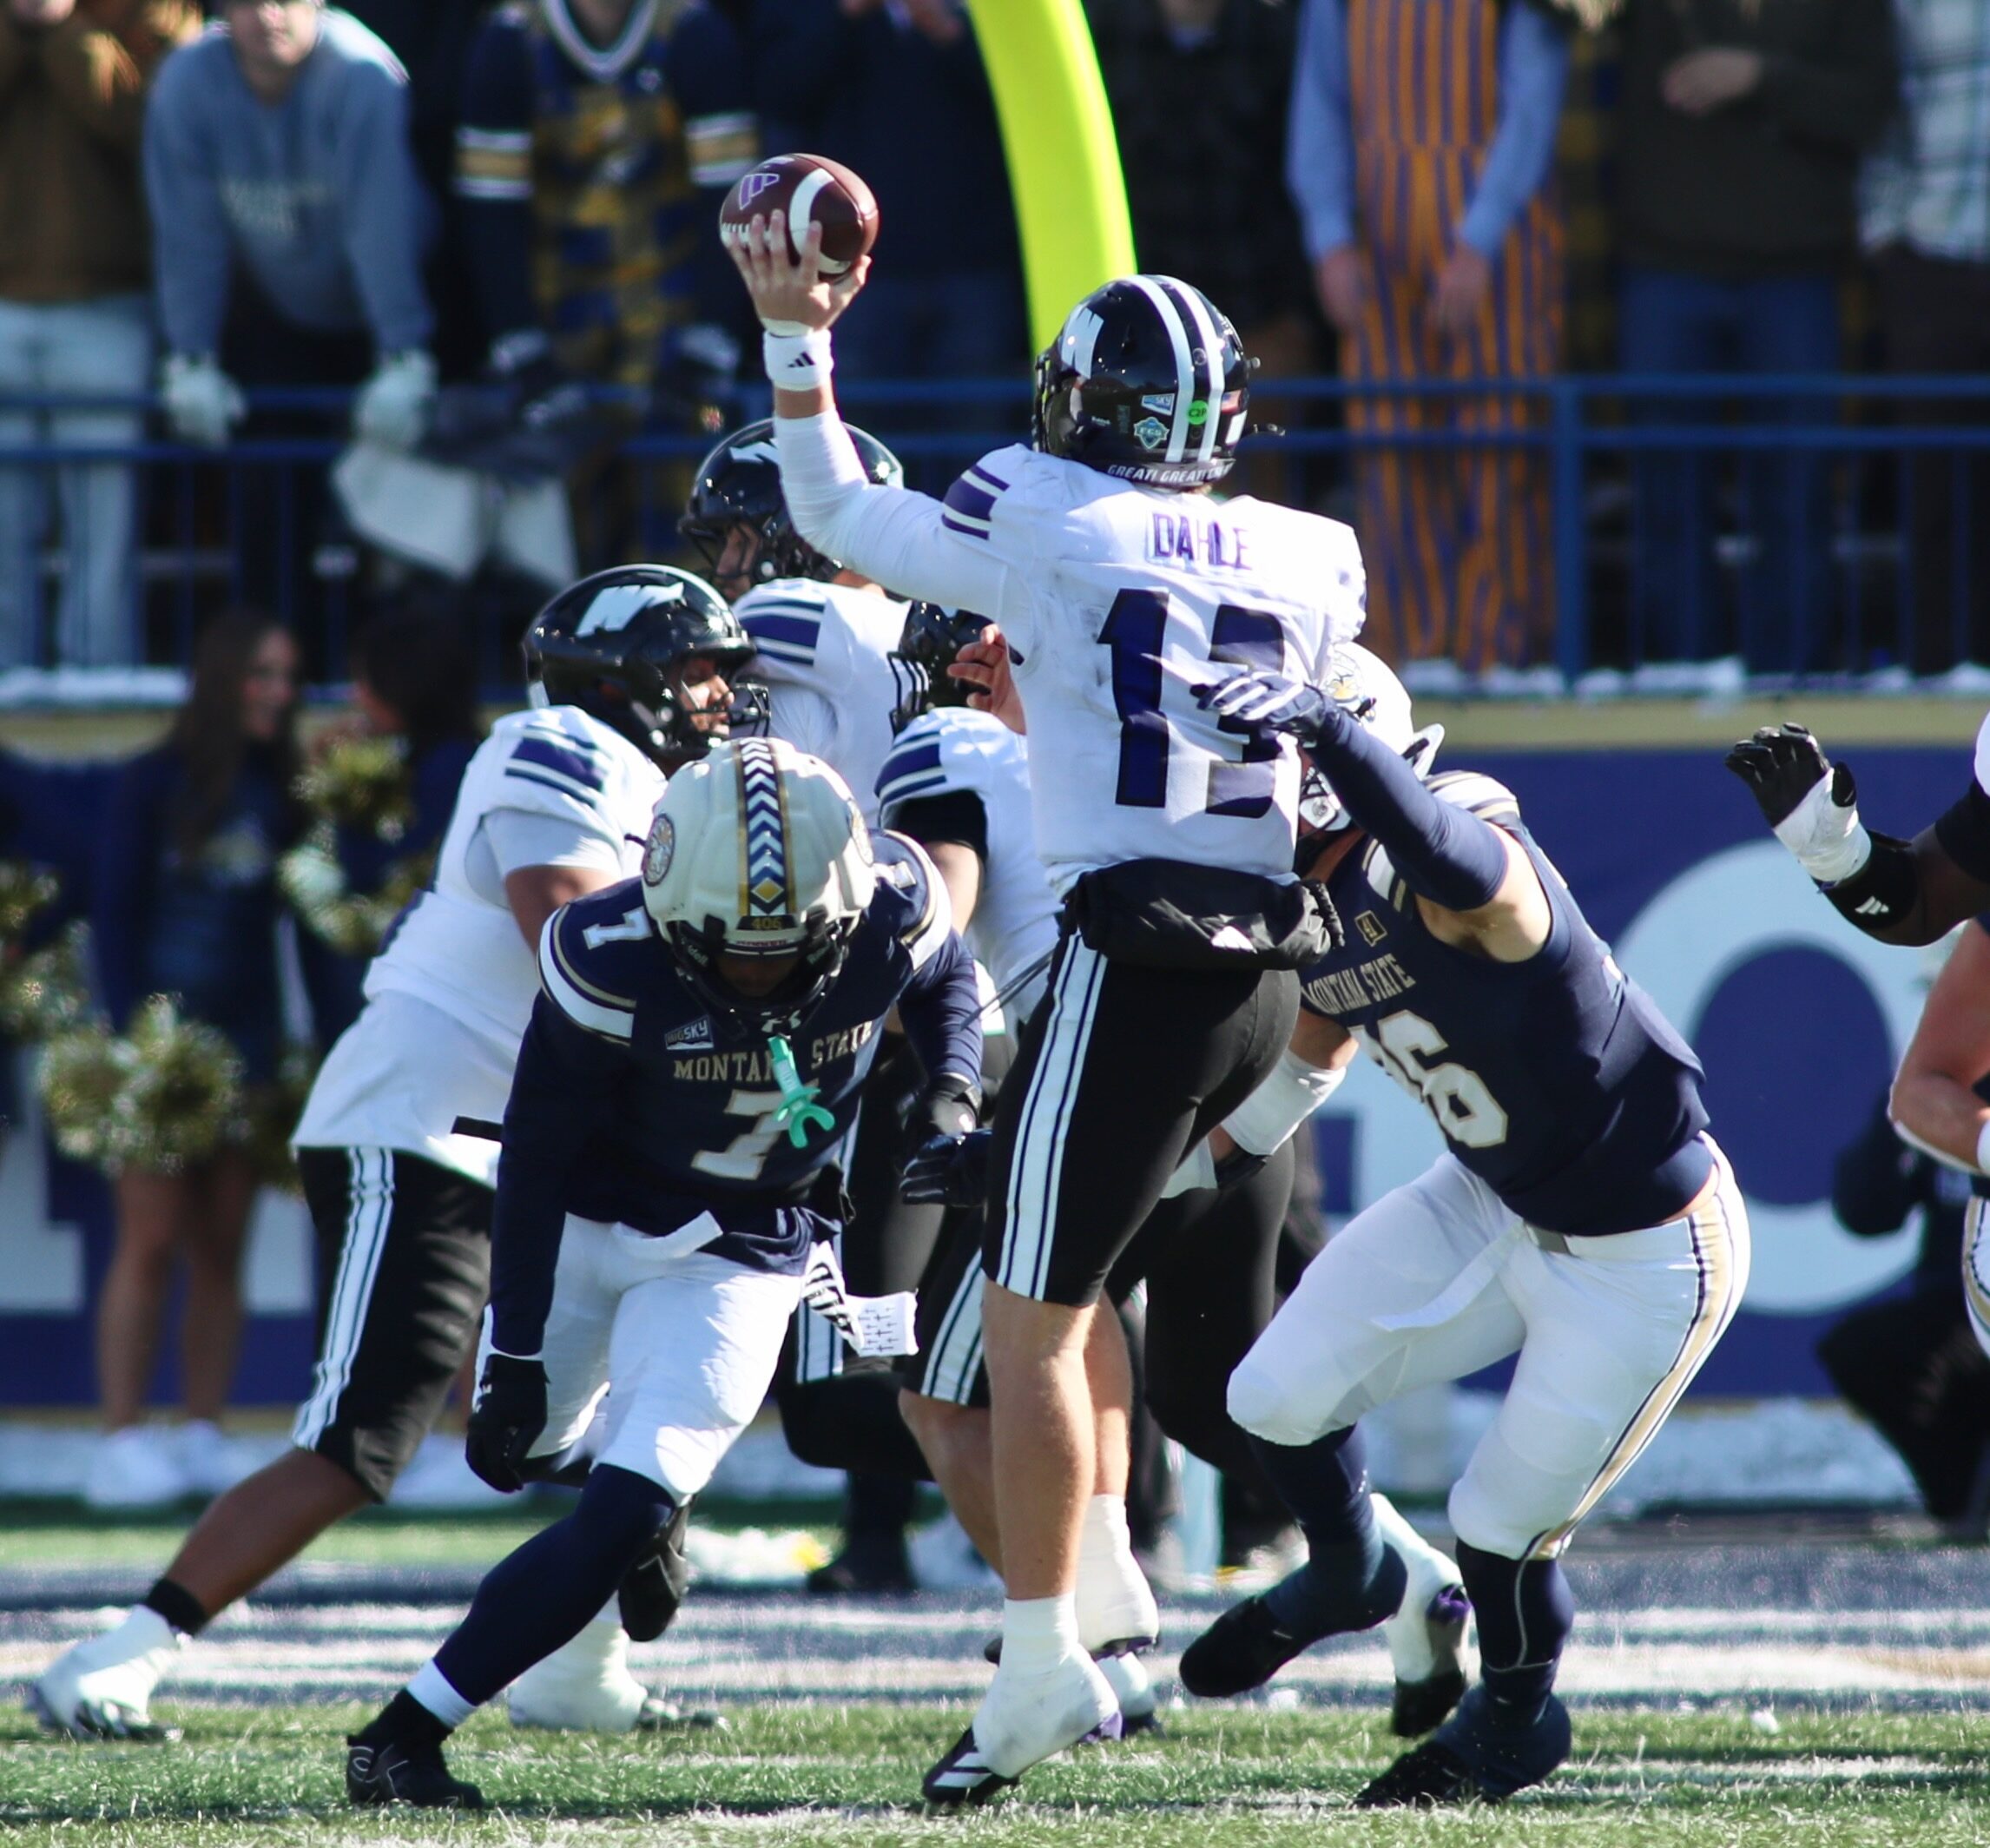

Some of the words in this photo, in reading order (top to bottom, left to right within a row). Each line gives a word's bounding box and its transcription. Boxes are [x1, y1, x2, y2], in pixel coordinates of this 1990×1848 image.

[1151, 512, 1252, 571] DAHLE
[1097, 587, 1284, 819] 13
[752, 917, 782, 930] 406
[1360, 954, 1417, 1002] STATE
[674, 1051, 774, 1082] MONTA
[811, 1020, 873, 1070] STATE
[691, 1079, 820, 1180] 7
